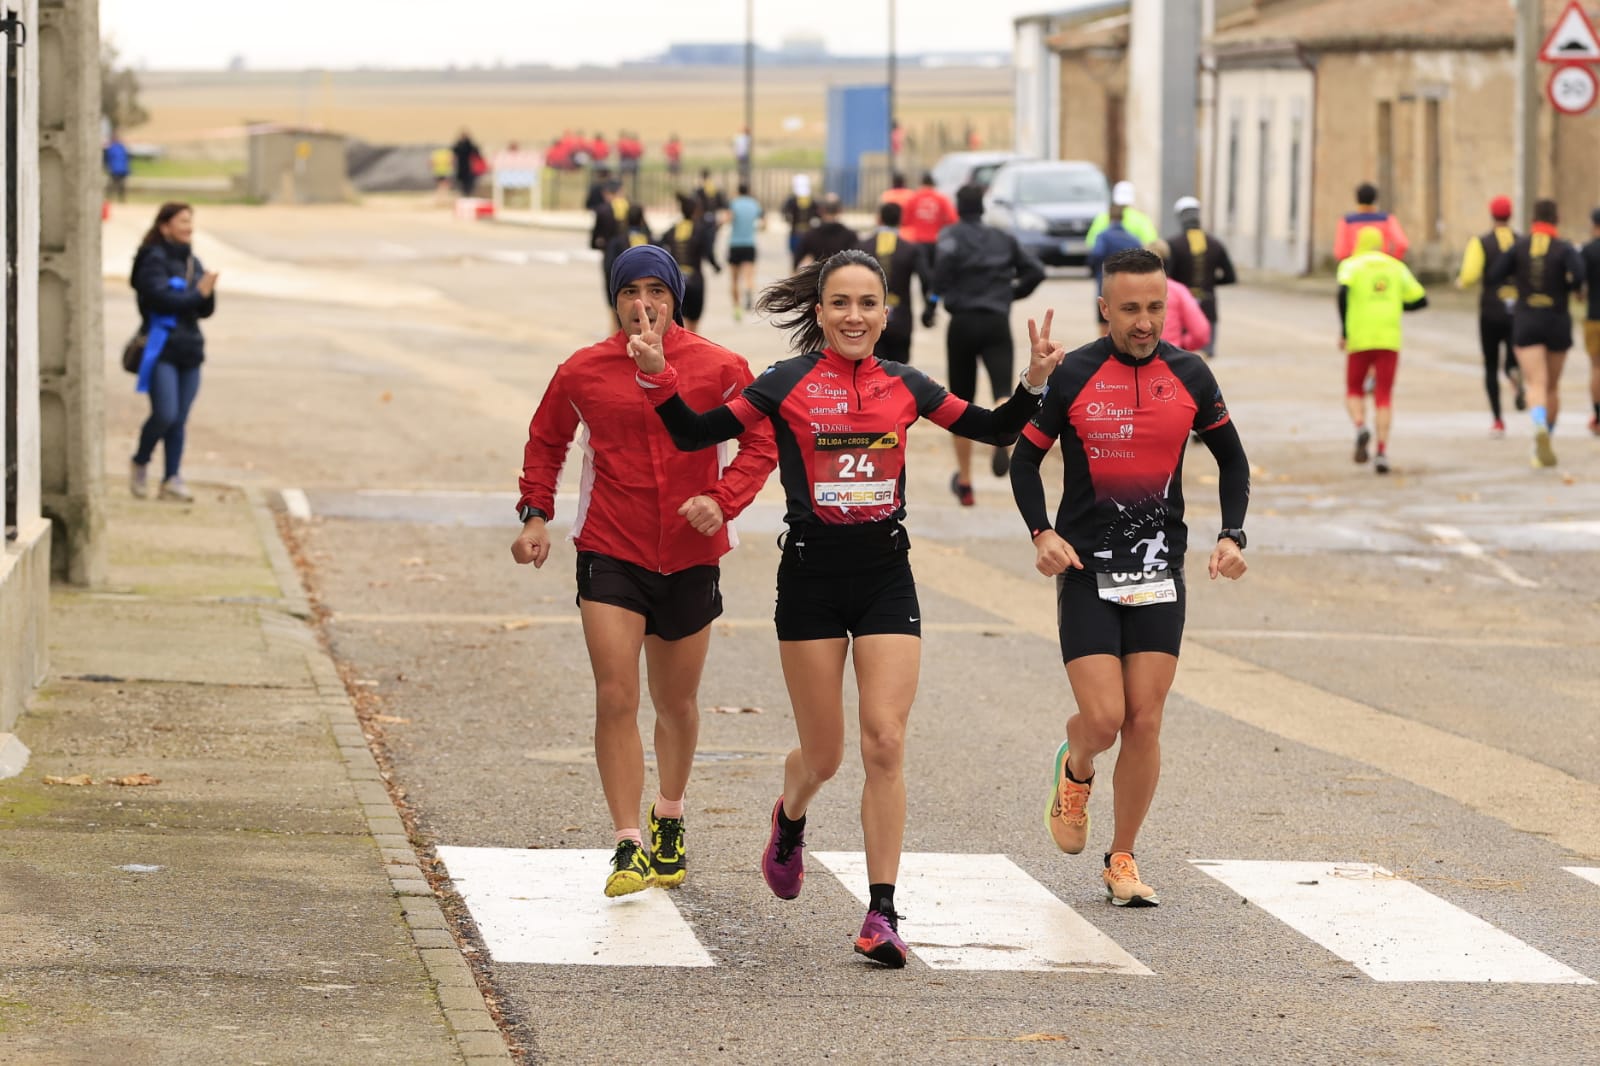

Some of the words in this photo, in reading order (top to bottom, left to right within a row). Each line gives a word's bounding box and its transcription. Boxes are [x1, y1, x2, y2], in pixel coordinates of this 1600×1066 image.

[809, 406, 839, 415] adamas
[1087, 430, 1121, 440] adamas
[817, 438, 826, 446] 33
[827, 438, 842, 446] LIGA
[847, 437, 870, 445] CROSS
[838, 454, 875, 478] 24
[817, 490, 892, 502] JOMISAGA
